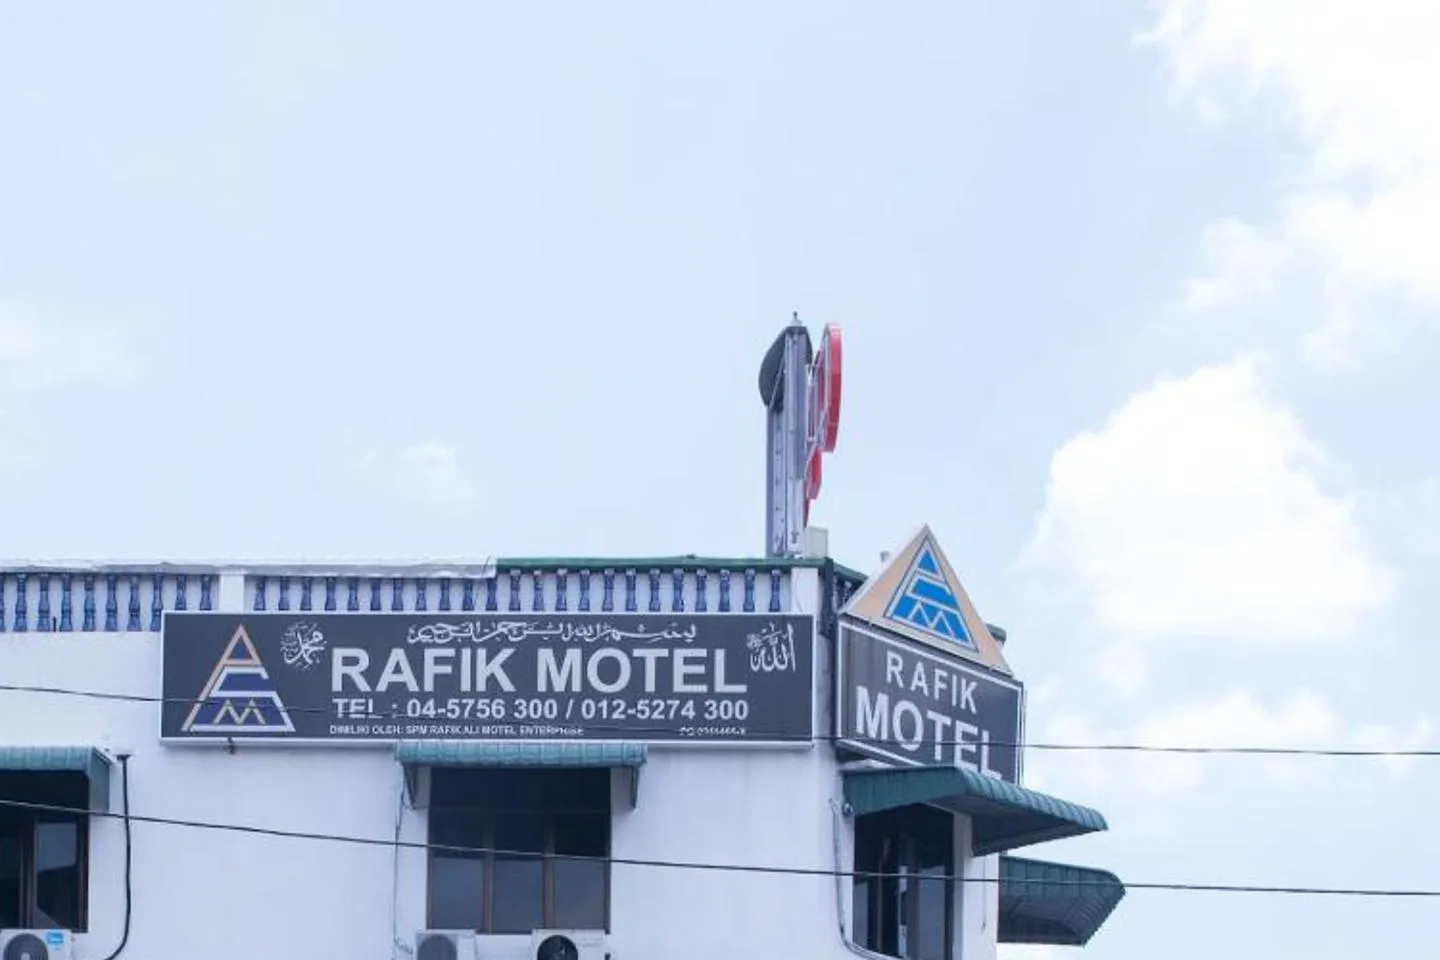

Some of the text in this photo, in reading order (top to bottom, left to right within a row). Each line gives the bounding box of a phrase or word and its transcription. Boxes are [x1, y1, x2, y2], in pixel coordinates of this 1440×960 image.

[331, 648, 747, 693] RAFIK MOTEL
[886, 650, 978, 714] RAFIK
[332, 698, 382, 719] TEL
[406, 698, 505, 719] 04-5756
[514, 698, 558, 719] 300
[581, 699, 695, 720] 012-5274
[704, 699, 749, 720] 300
[856, 686, 1002, 781] MOTEL
